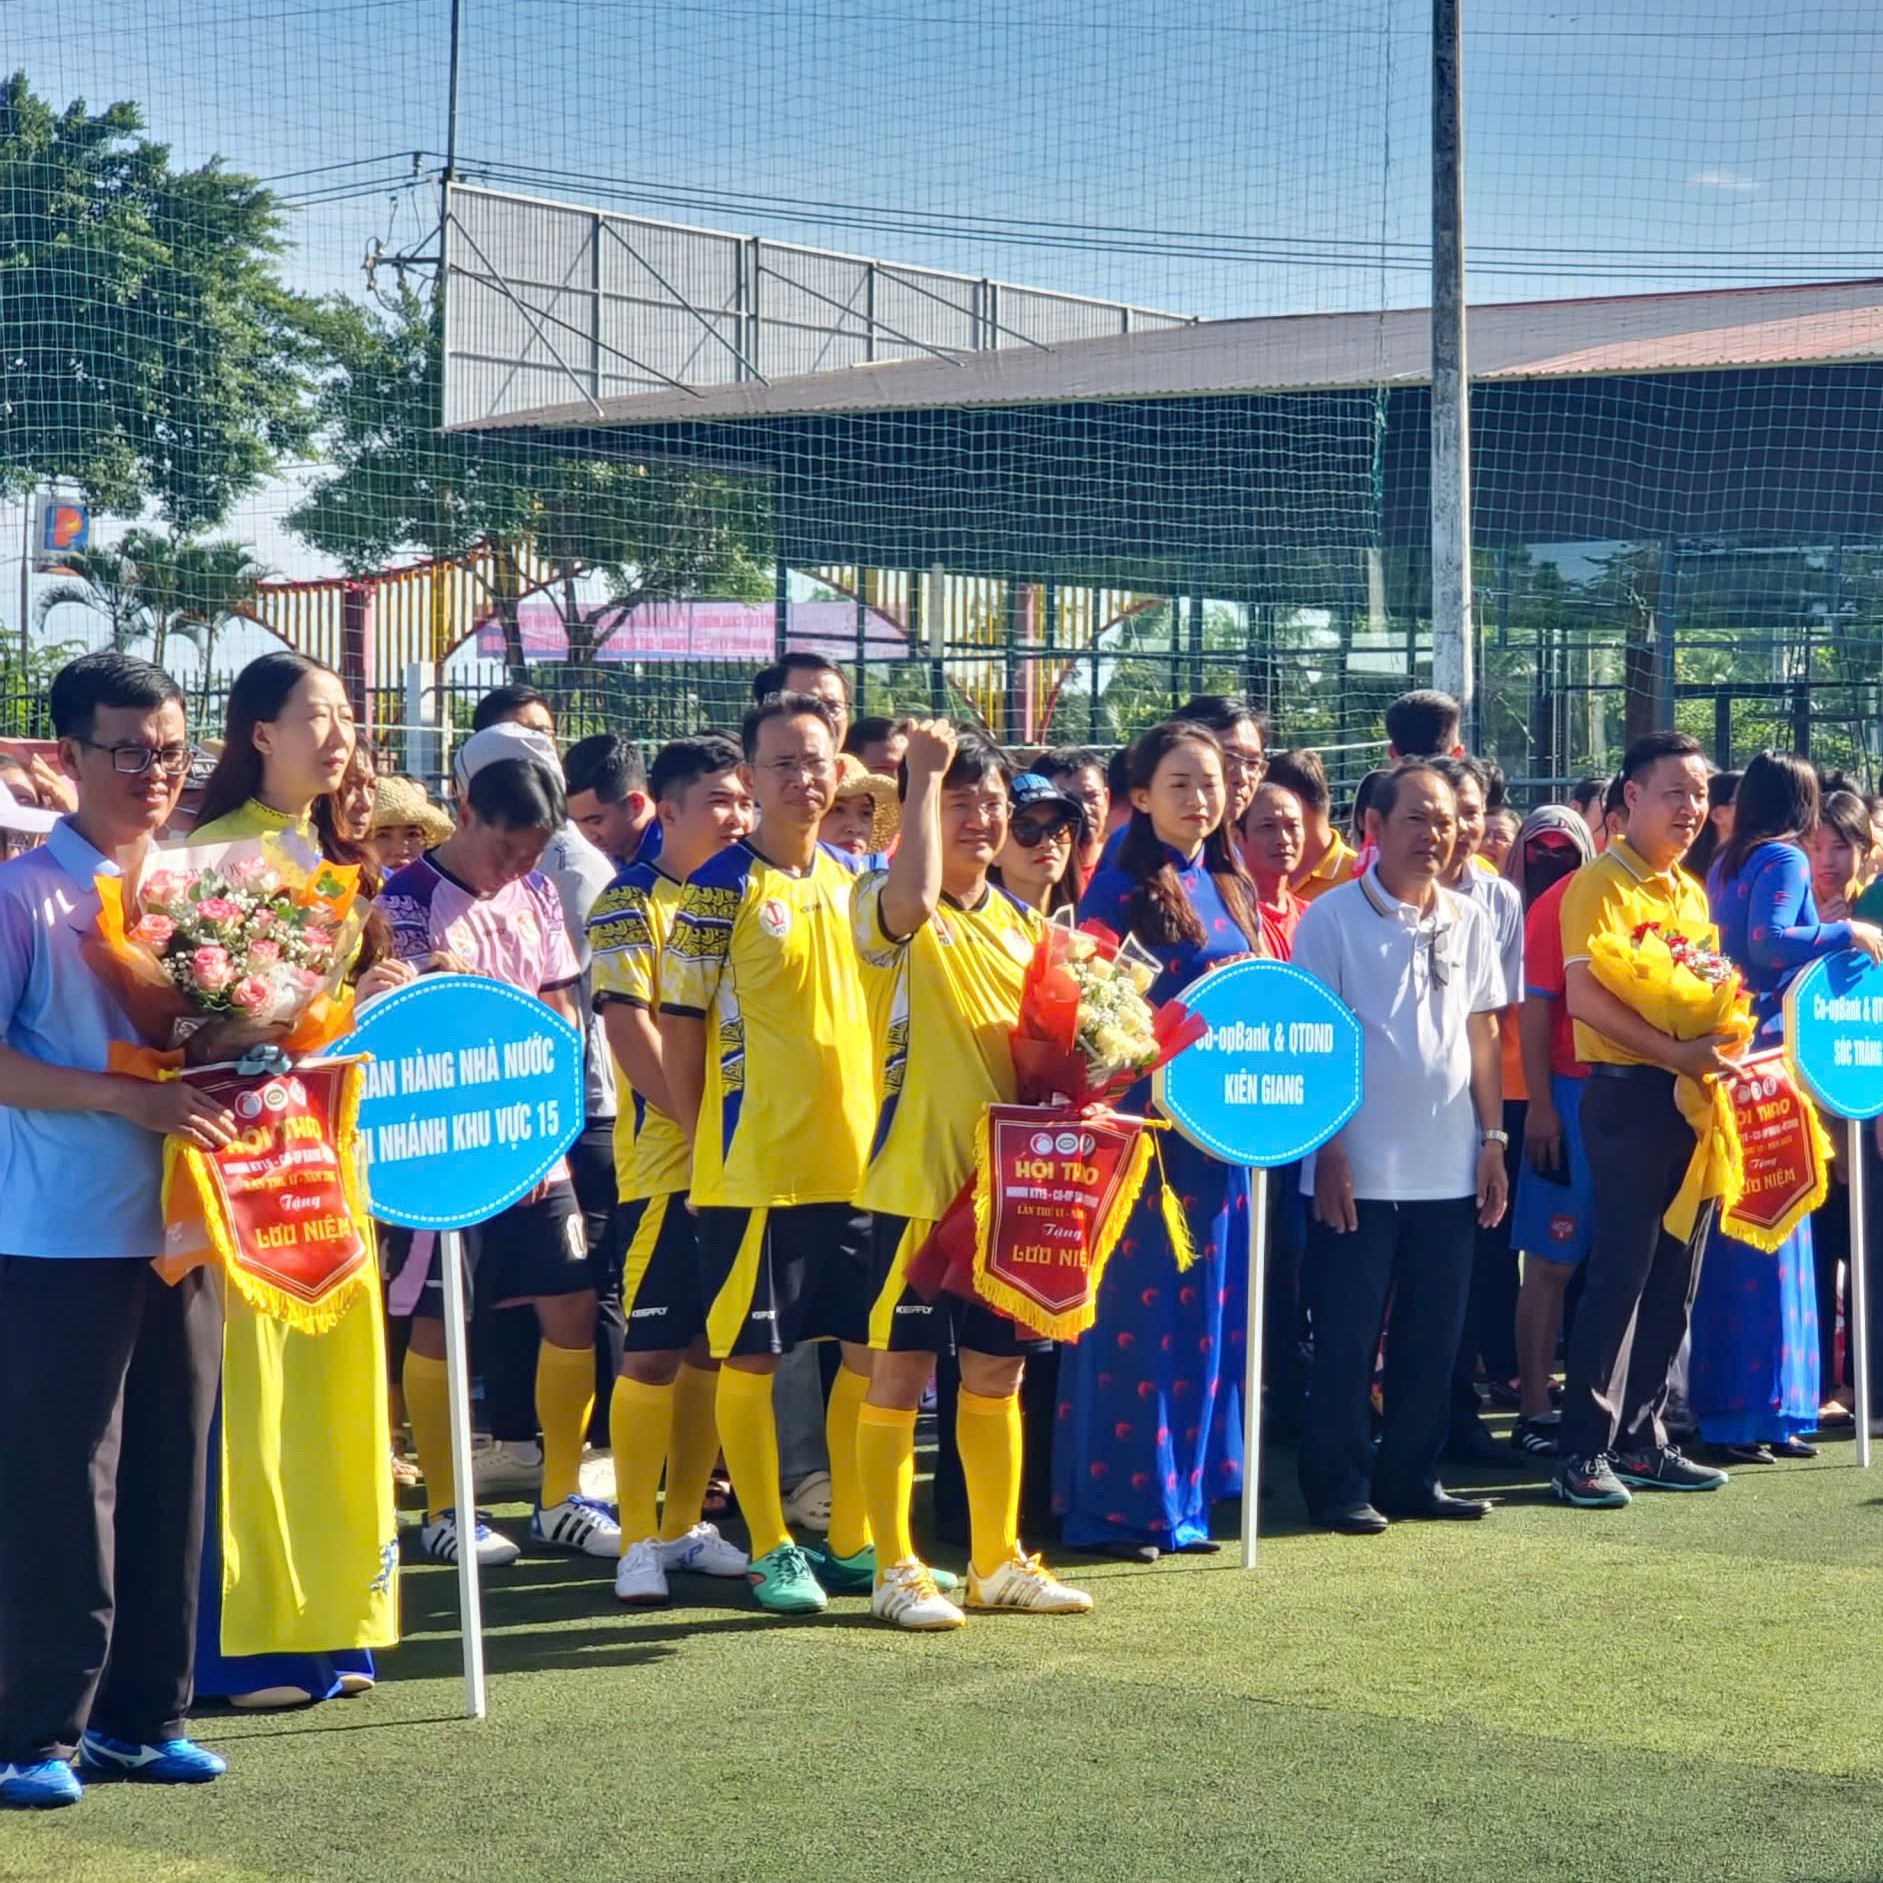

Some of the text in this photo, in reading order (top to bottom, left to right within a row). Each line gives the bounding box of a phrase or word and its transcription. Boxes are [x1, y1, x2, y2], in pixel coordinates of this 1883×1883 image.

[1814, 994, 1861, 1024] Co-opBank
[1863, 996, 1870, 1022] &
[1274, 1022, 1285, 1053] &
[1289, 1022, 1334, 1056] QTDND
[1833, 1034, 1852, 1067] SÓC
[401, 1048, 455, 1095] HÀNG
[459, 1038, 499, 1086] NHÀ
[504, 1032, 555, 1079] NƯỚC
[1224, 1068, 1304, 1105] KIÊN GIANG
[378, 1113, 448, 1163] NHÁNH
[452, 1110, 491, 1151] KHU
[495, 1101, 532, 1150] VỰC
[537, 1100, 559, 1138] 15
[1015, 1157, 1055, 1184] HỘI
